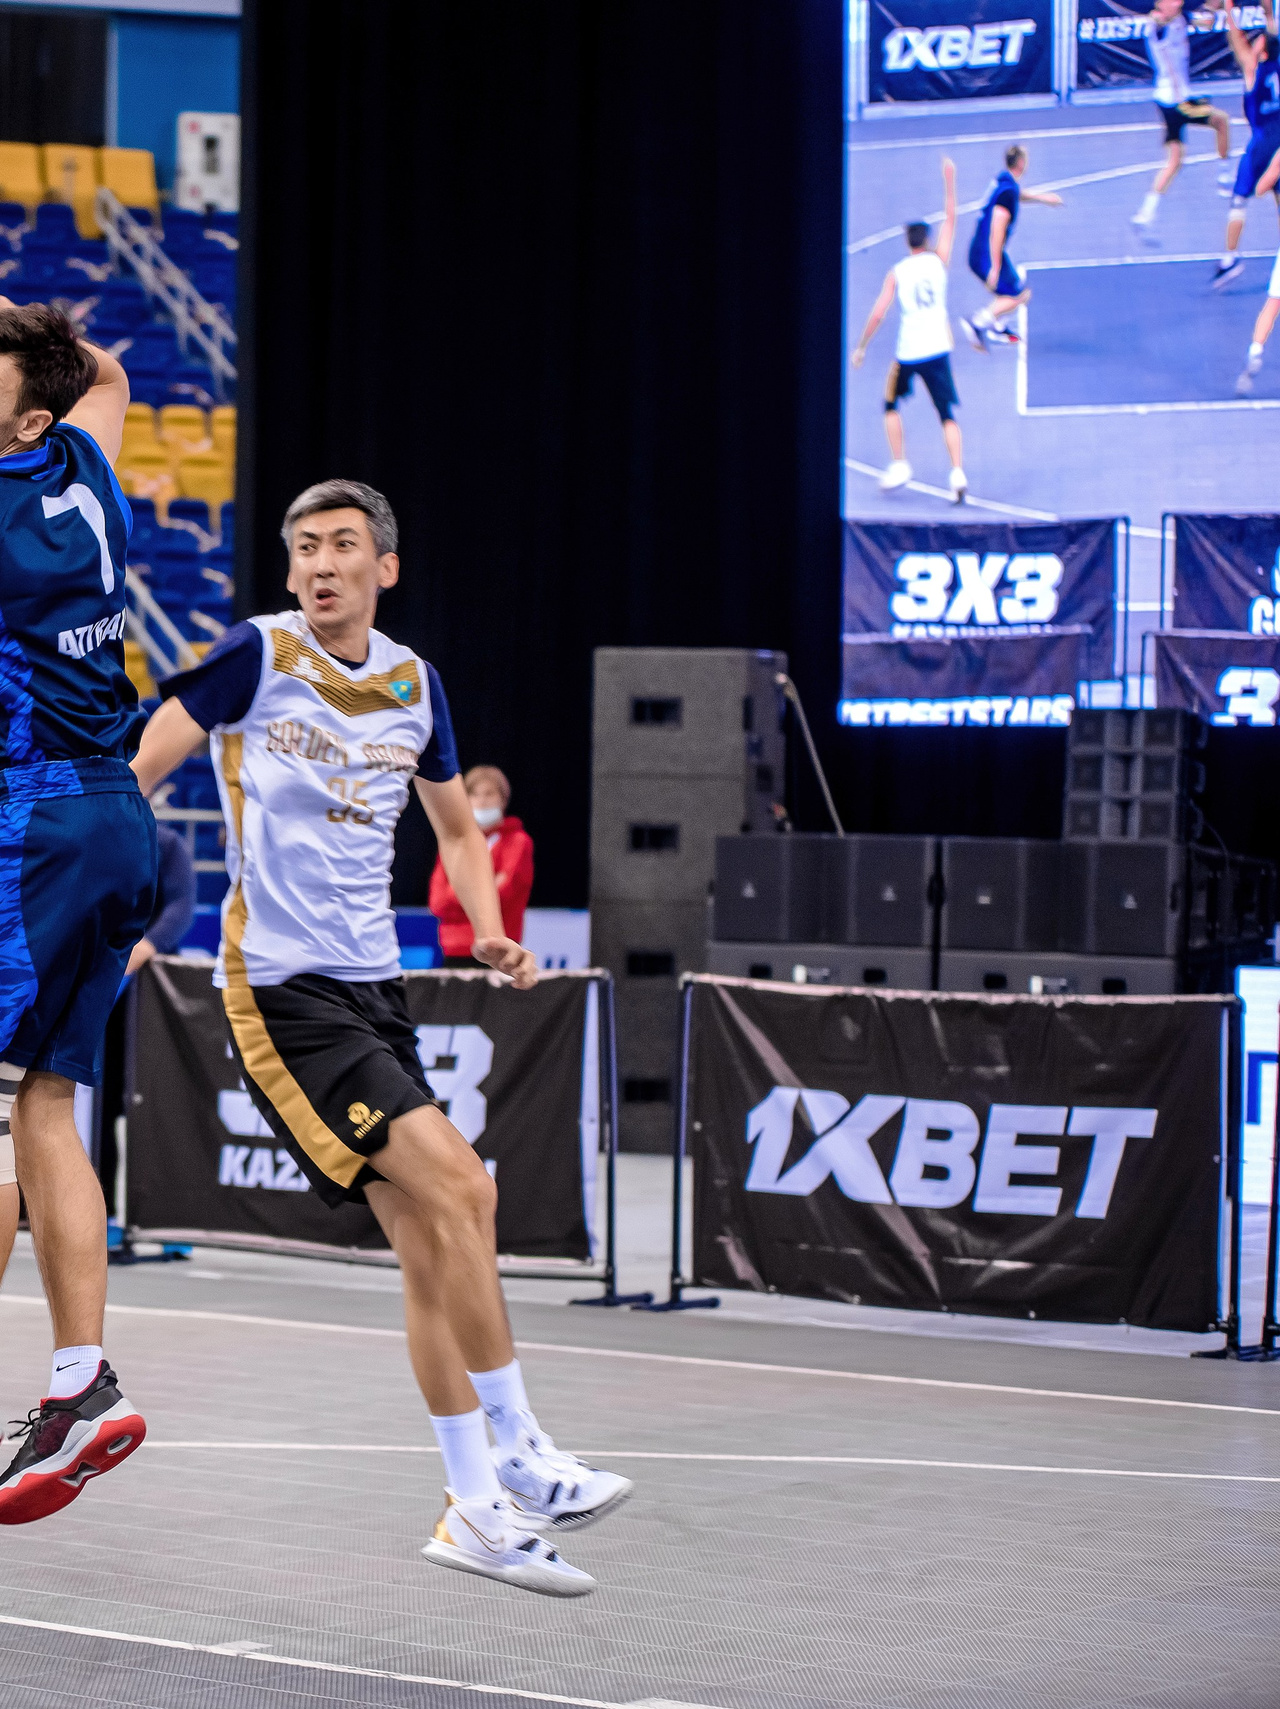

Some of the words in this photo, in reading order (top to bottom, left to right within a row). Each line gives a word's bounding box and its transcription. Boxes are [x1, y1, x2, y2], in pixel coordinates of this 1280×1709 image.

[882, 18, 1037, 72] 1XBET
[41, 482, 115, 595] 7
[890, 552, 1065, 624] 3X3
[745, 1085, 1158, 1220] 1XBET
